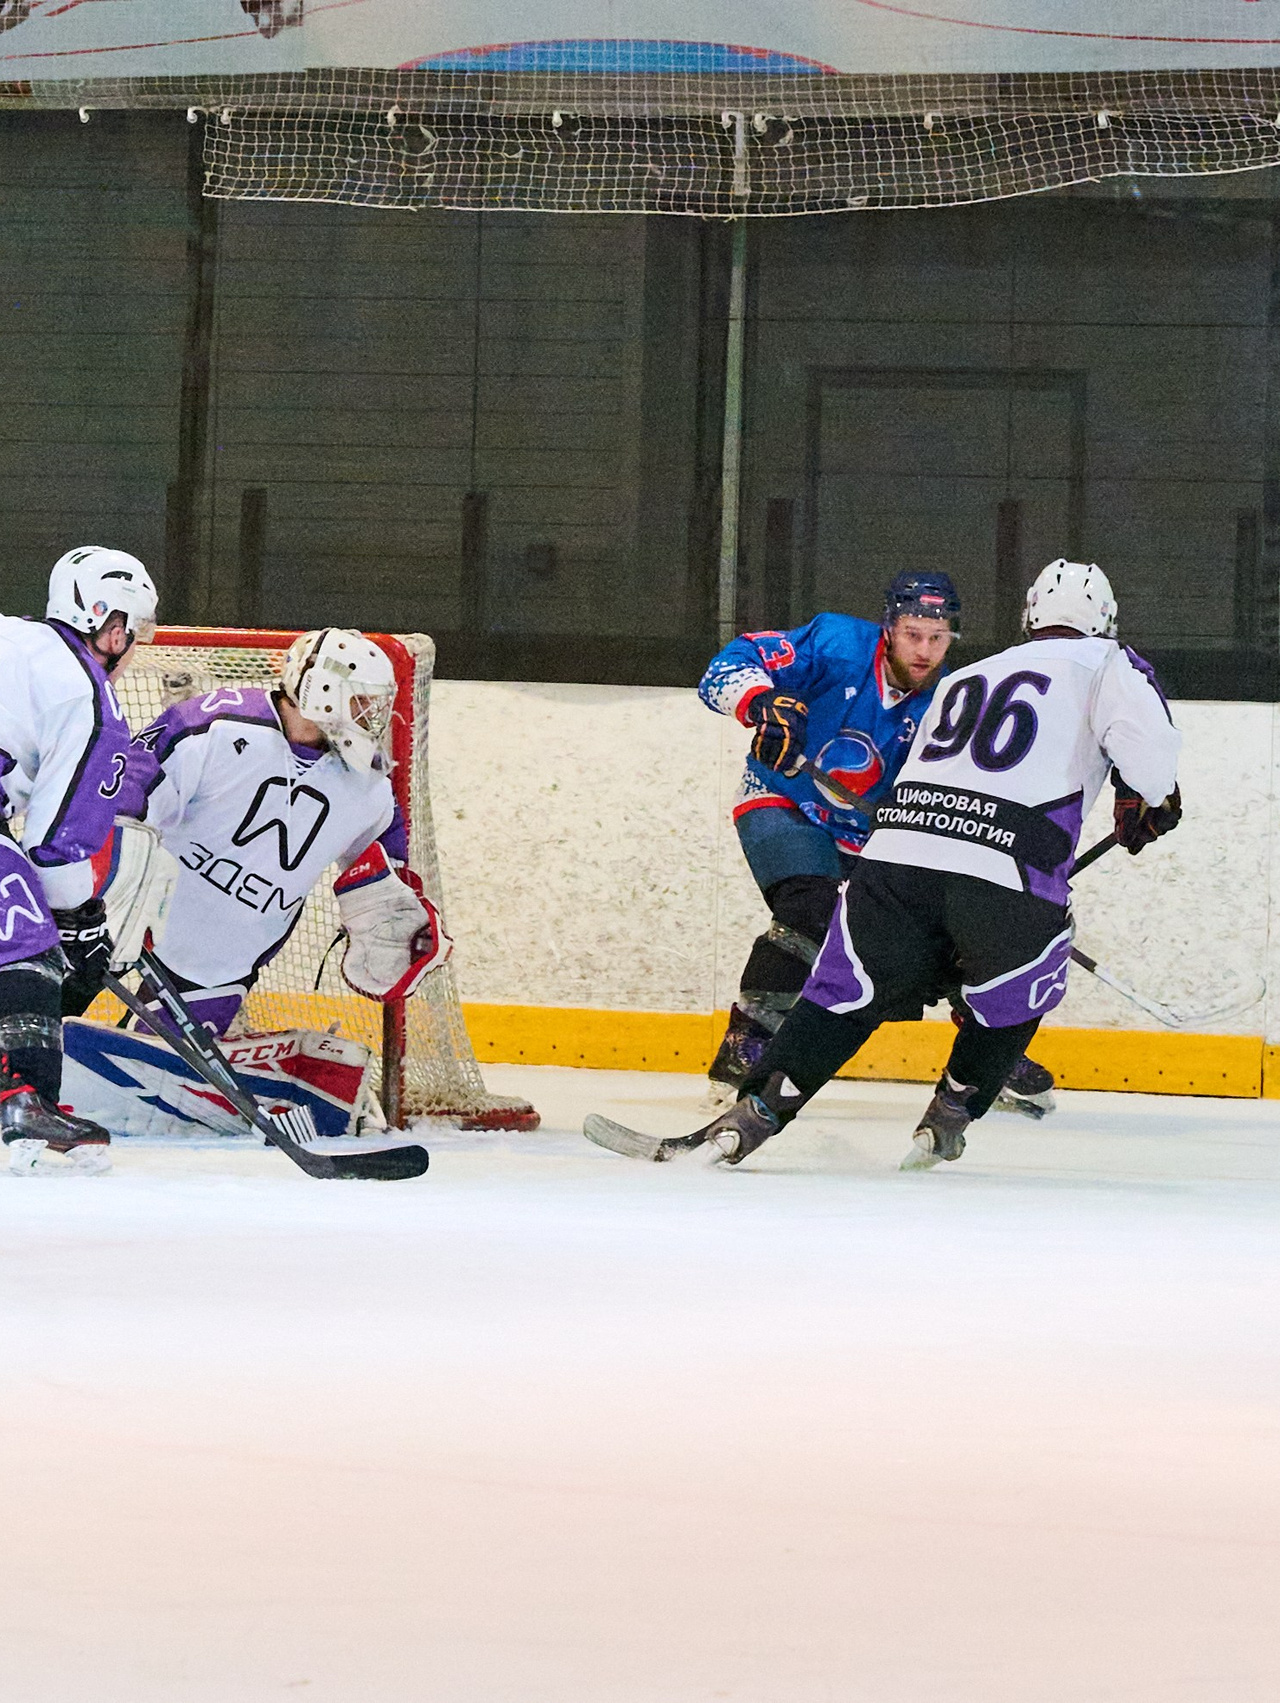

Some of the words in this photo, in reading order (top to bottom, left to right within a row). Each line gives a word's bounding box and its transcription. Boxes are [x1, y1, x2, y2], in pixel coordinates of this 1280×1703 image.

[918, 670, 1052, 773] 96
[97, 752, 128, 800] 3
[896, 787, 998, 819] ЦИФРОВАЯ
[876, 807, 1016, 848] СТОМАТОЛОГИЯ
[229, 1039, 296, 1064] CCM
